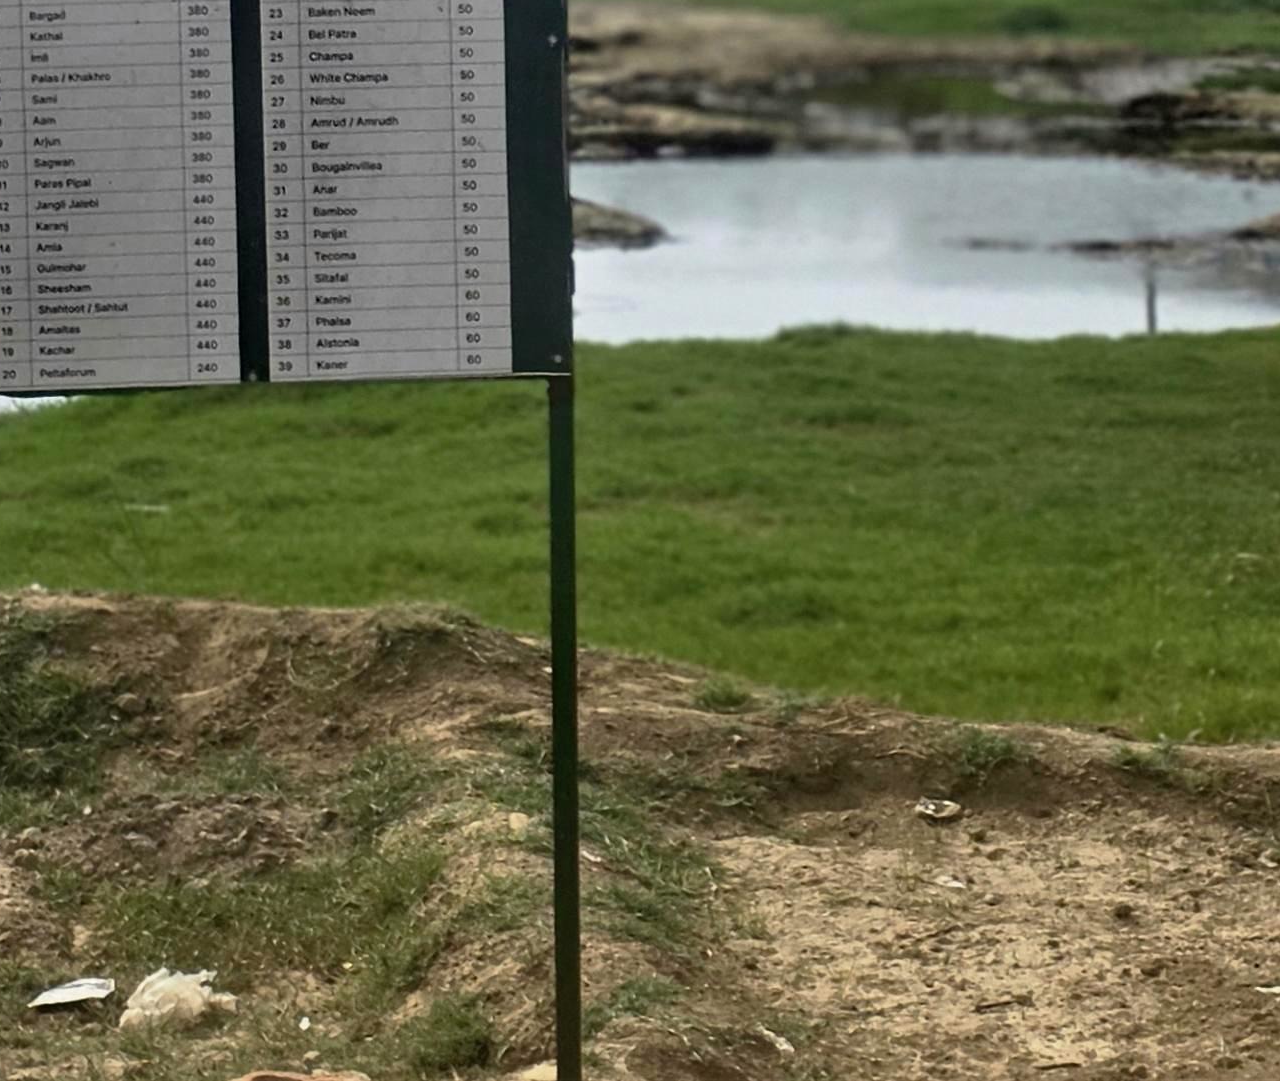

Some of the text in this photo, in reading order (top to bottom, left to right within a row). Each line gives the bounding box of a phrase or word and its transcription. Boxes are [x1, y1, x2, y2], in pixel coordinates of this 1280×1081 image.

[269, 9, 283, 18] 23
[343, 6, 375, 16] Neem
[30, 31, 63, 41] Kathal
[270, 31, 283, 40] 24
[270, 53, 284, 63] 25
[309, 51, 353, 63] Champa
[271, 72, 388, 84] 26 White Champa
[271, 97, 284, 107] 27
[310, 96, 345, 105] Nimbu
[272, 119, 286, 129] 28
[349, 117, 354, 127] /
[34, 137, 61, 147] Arjun
[311, 140, 330, 150] Ber
[273, 164, 287, 173] 30
[273, 185, 337, 196] 31 Anar
[274, 208, 289, 217] 32
[313, 206, 357, 217] Bamboo
[0, 223, 10, 232] 13
[0, 244, 11, 253] 14
[275, 253, 289, 262] 34
[314, 251, 356, 261] Tecoma
[0, 265, 11, 274] 15
[276, 275, 290, 285] 35
[276, 296, 290, 306] 36
[315, 295, 351, 304] Kamini
[1, 306, 13, 315] 17
[277, 318, 291, 328] 37
[277, 340, 292, 350] 38
[278, 362, 292, 371] 39
[2, 370, 16, 379] 20
